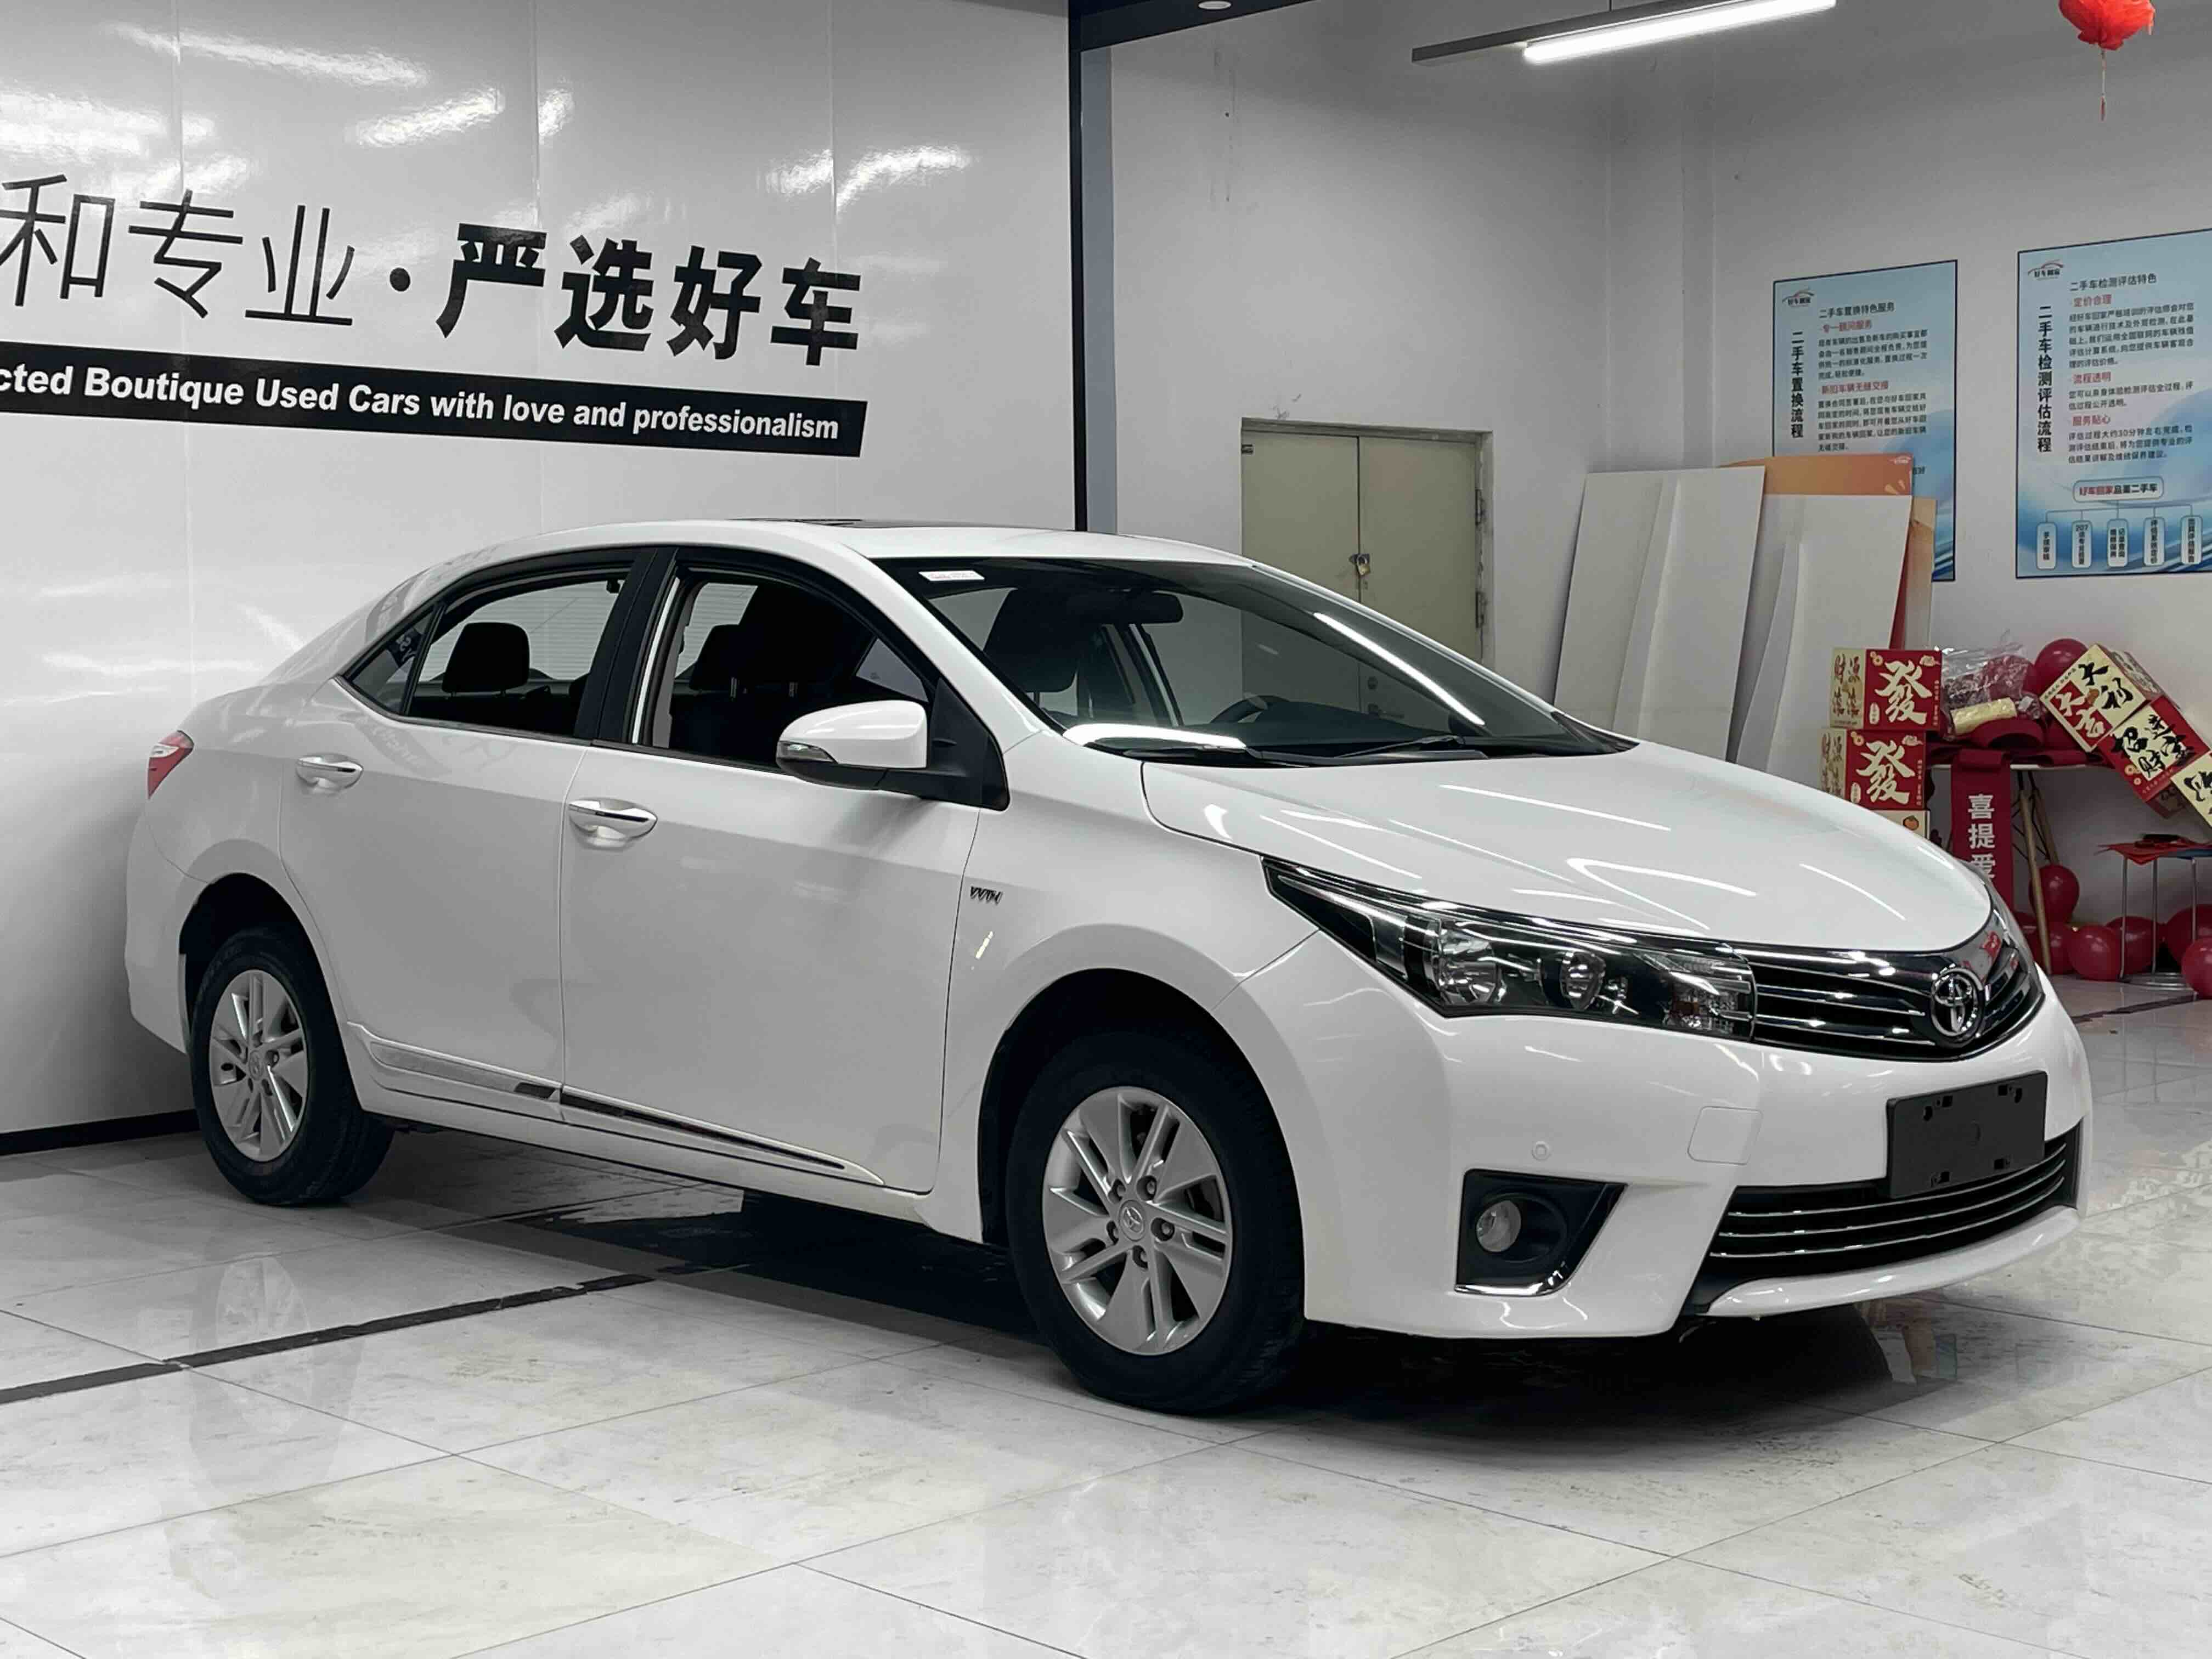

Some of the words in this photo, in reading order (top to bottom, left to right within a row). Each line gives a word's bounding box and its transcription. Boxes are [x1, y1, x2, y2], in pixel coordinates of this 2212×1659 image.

[84, 368, 244, 409] Boutique
[257, 379, 338, 410] Used
[349, 385, 419, 415] Cars
[431, 392, 493, 419] with
[504, 394, 564, 423] love
[574, 402, 626, 426] and
[633, 406, 838, 438] professionalism
[1791, 331, 1804, 438] 二手车置换流程
[2038, 305, 2052, 452] 二手车检测评估流程
